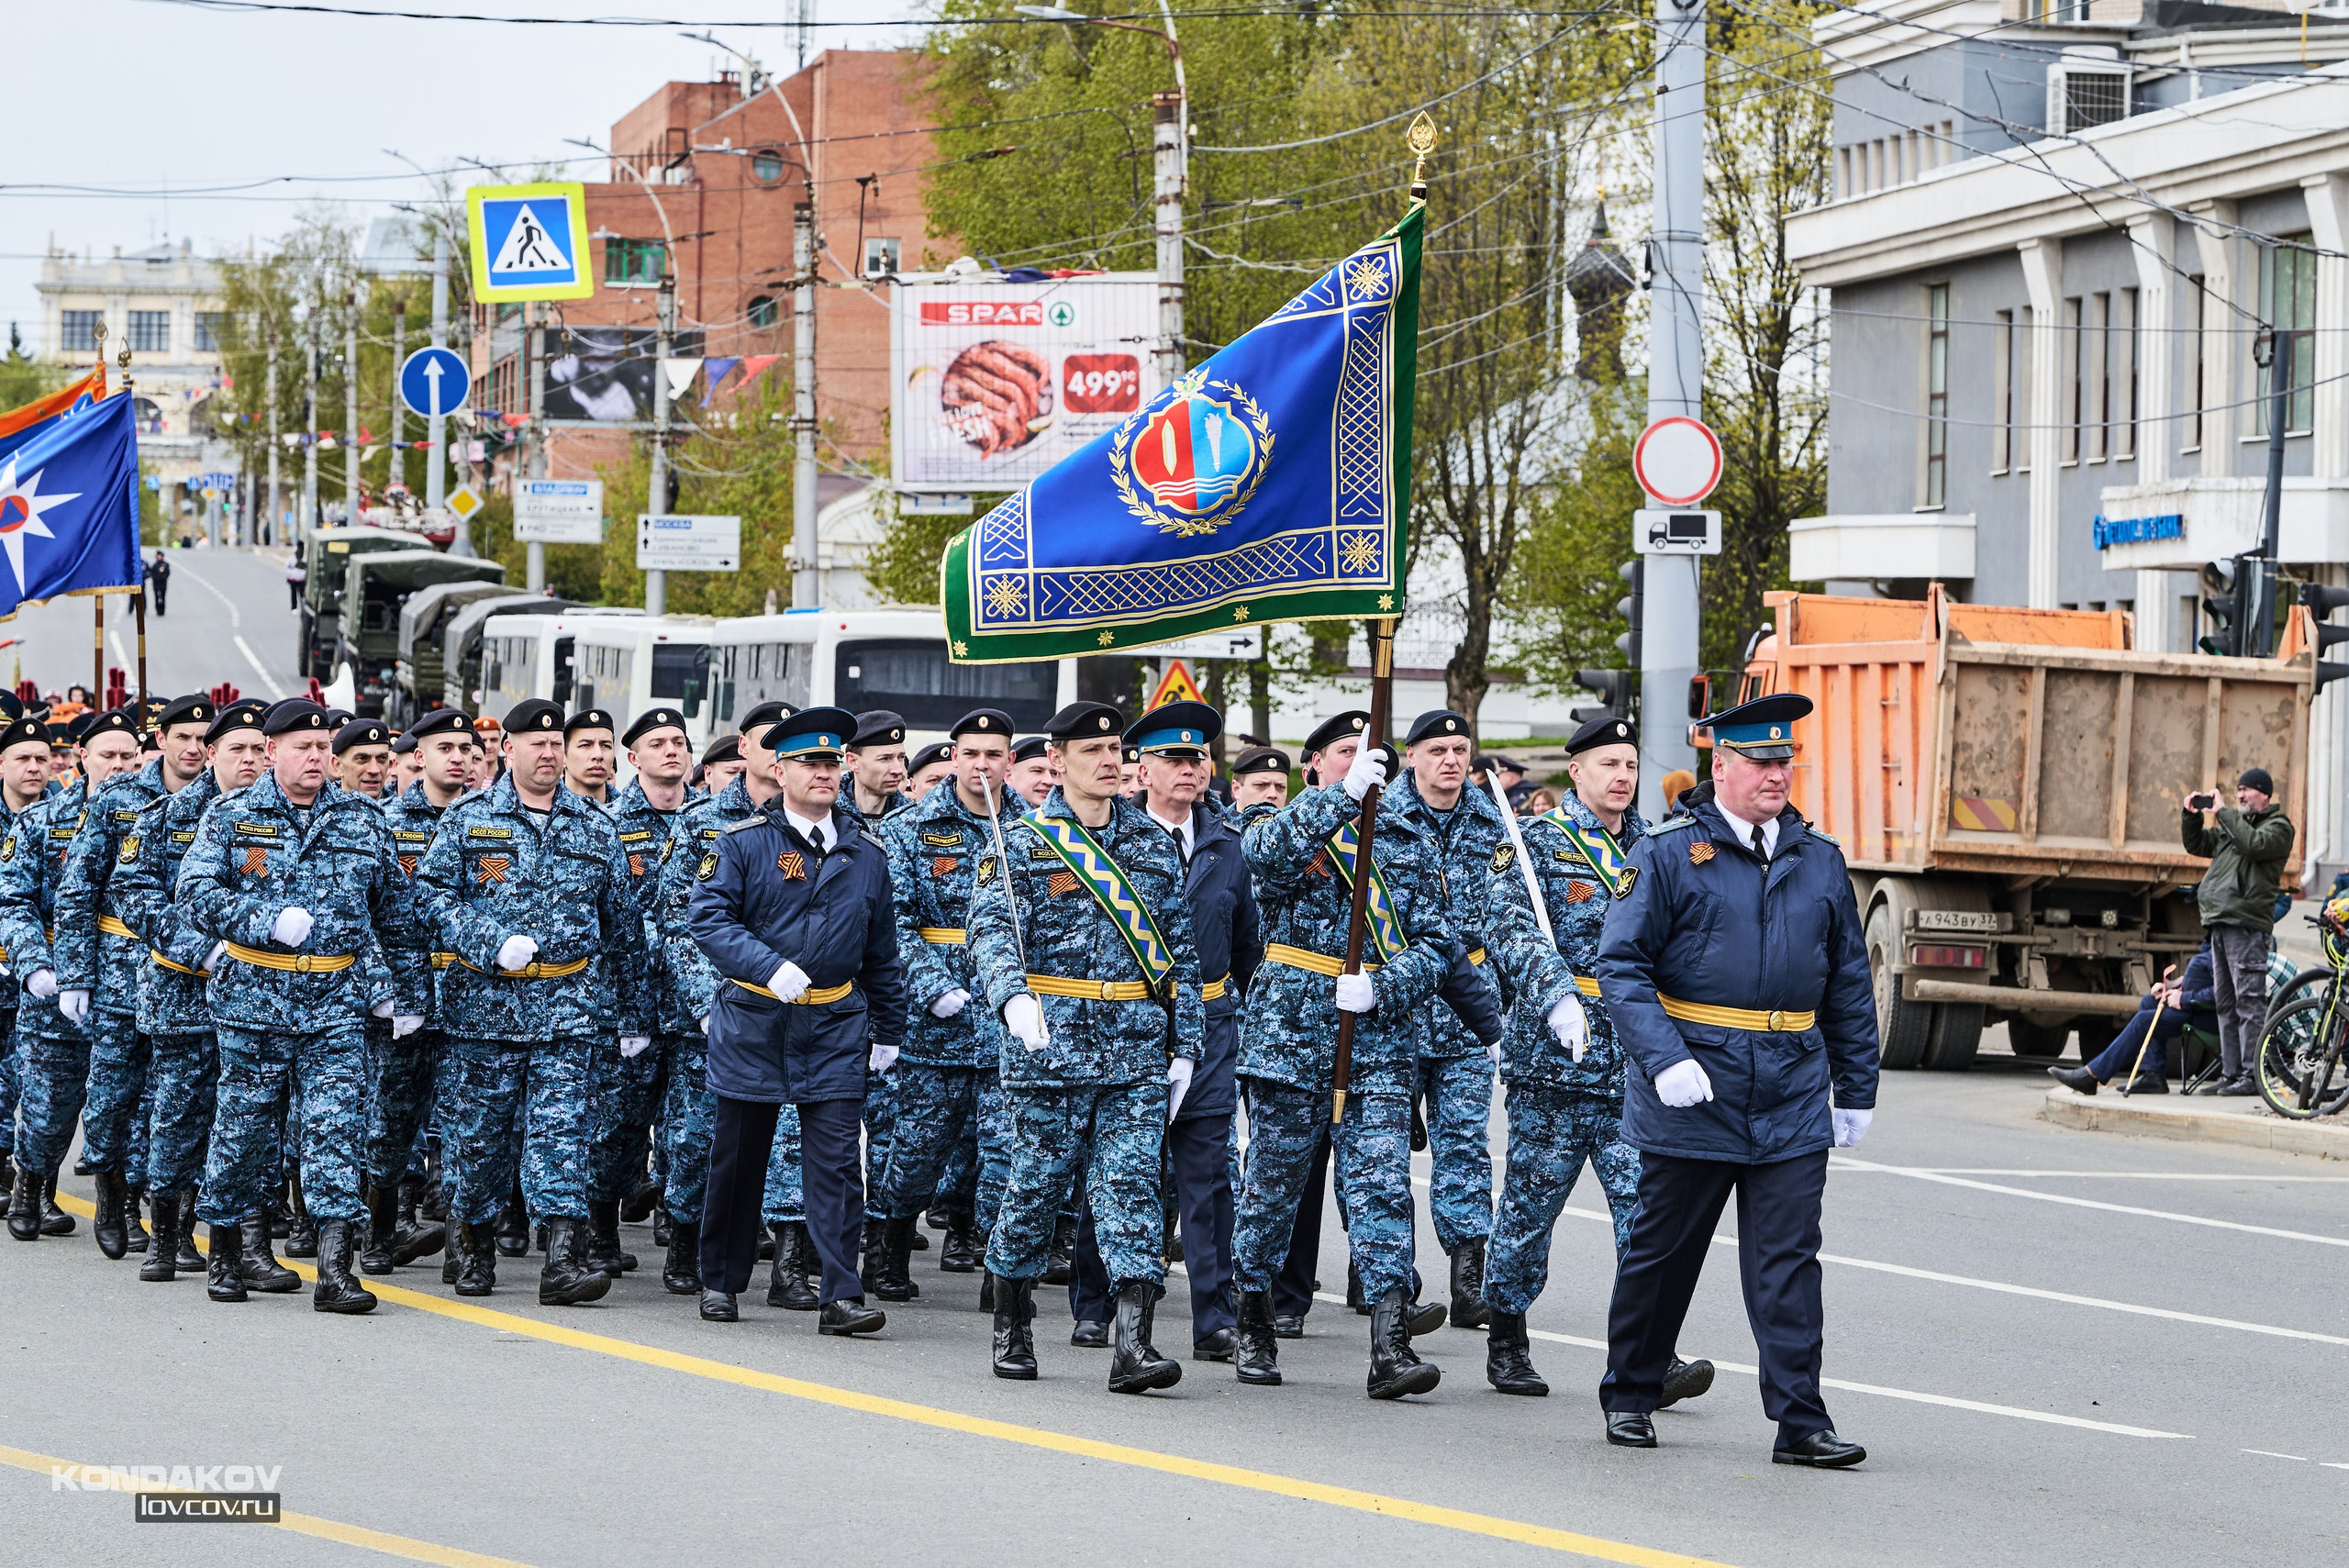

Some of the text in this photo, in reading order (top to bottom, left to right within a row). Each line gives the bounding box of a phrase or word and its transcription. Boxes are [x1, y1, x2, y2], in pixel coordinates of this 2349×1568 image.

[948, 304, 1041, 323] SPAR
[1067, 370, 1122, 397] 499
[1980, 914, 1993, 924] 37
